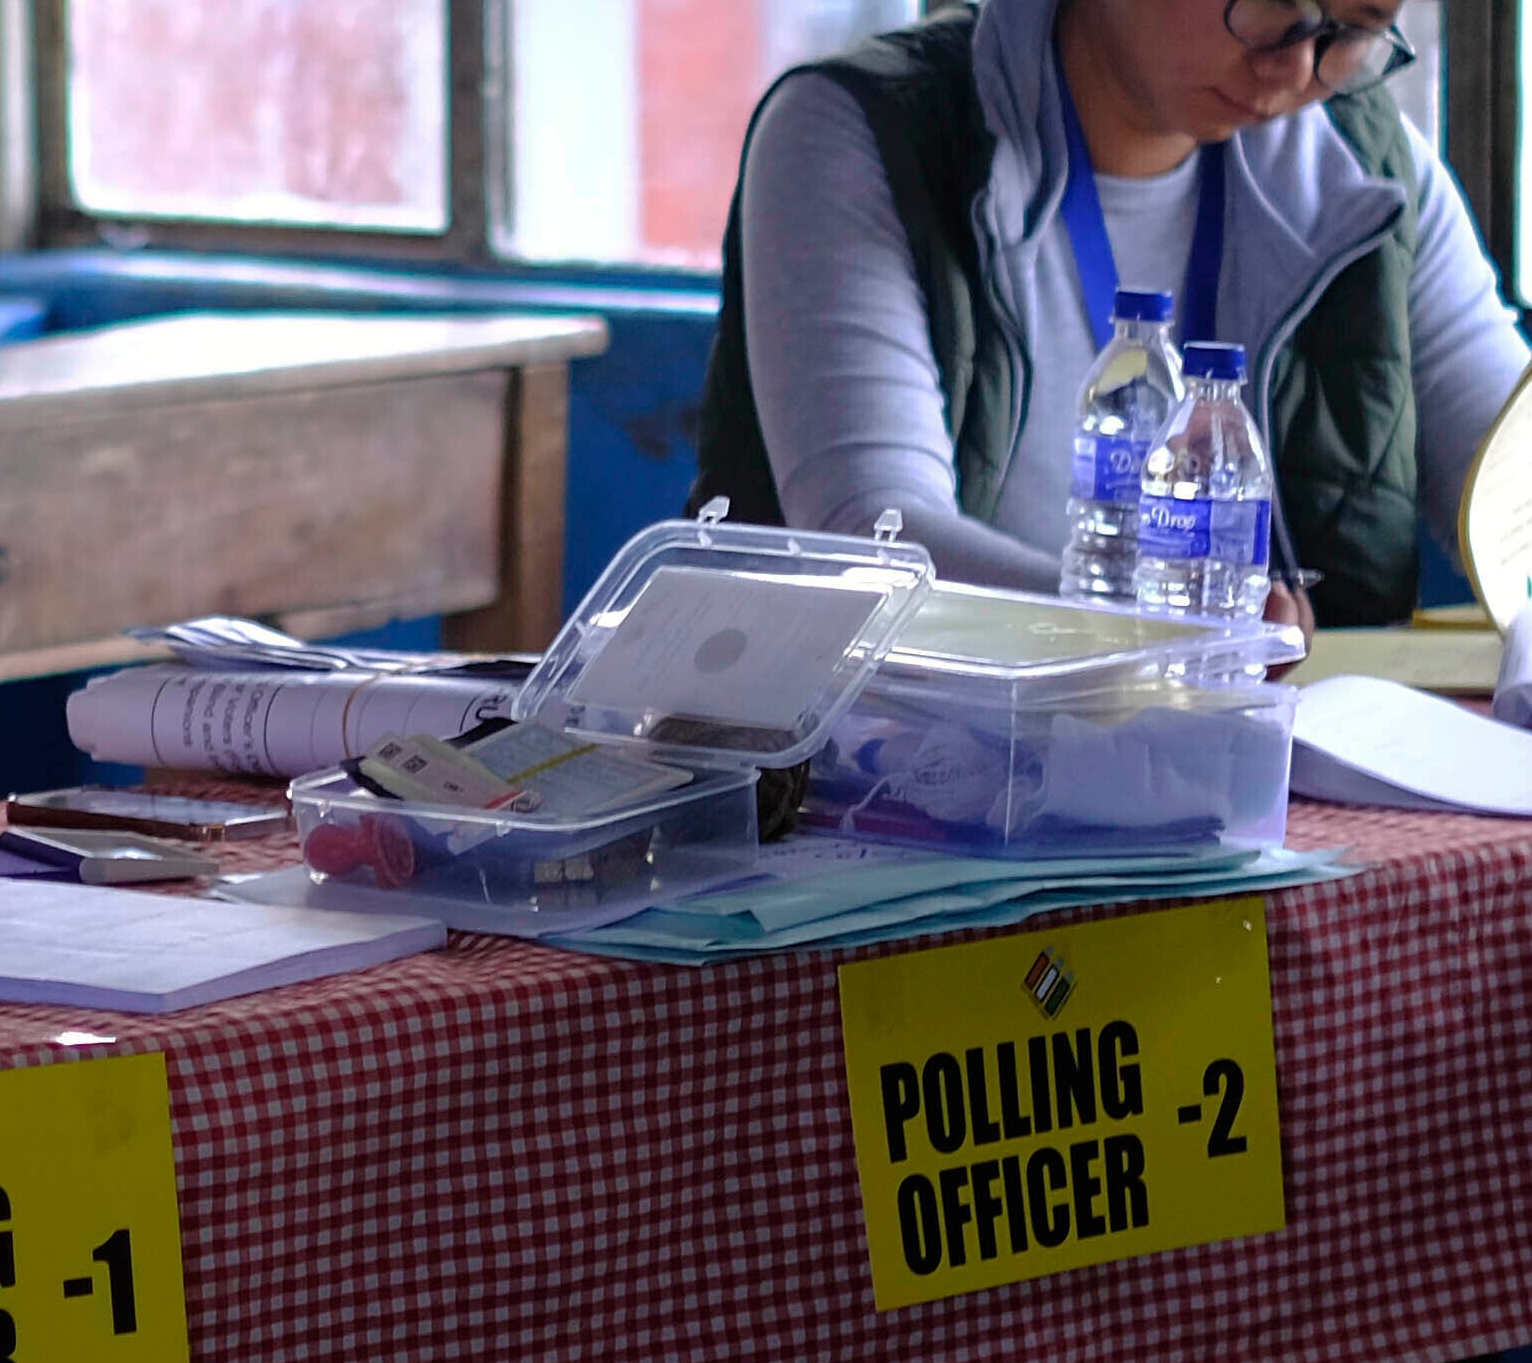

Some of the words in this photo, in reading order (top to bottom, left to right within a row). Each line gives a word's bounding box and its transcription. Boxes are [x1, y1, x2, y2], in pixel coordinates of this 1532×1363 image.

[880, 1020, 1144, 1163] POLLING
[1178, 1058, 1247, 1158] -2
[897, 1134, 1149, 1275] OFFICER
[63, 1229, 137, 1335] -1
